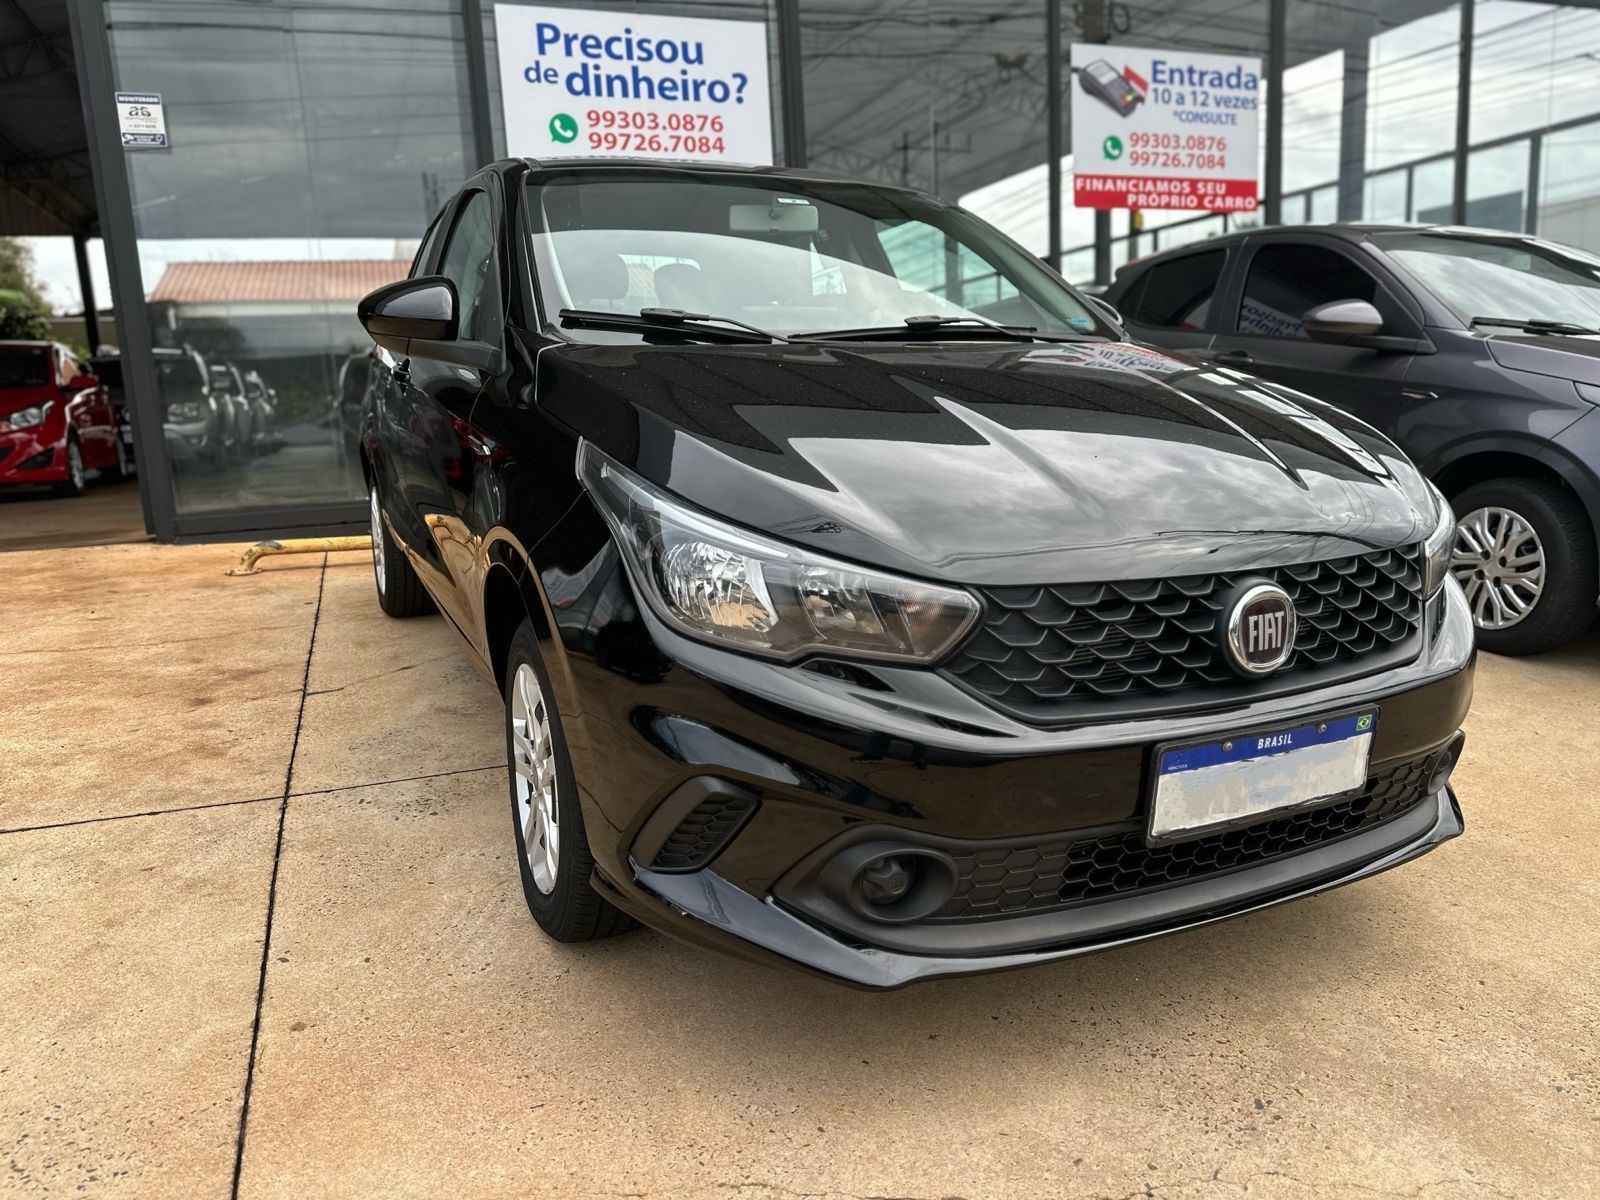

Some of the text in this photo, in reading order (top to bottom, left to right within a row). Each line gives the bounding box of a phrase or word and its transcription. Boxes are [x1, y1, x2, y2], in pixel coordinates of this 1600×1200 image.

[536, 22, 704, 65] Precisou
[524, 60, 748, 104] de dinheiro?
[1151, 60, 1258, 90] Entrada
[1153, 88, 1258, 110] 10 a 12 vezes
[586, 109, 724, 132] 99303.0876
[588, 132, 725, 154] 99726.7084
[1129, 132, 1226, 151] 99303.0876
[1129, 151, 1226, 170] 99726.7084
[1076, 177, 1226, 194] FINANCIAMOS SEU
[1203, 196, 1257, 209] CARRO
[1248, 611, 1285, 652] FIAT
[1257, 733, 1293, 750] BRASIL
